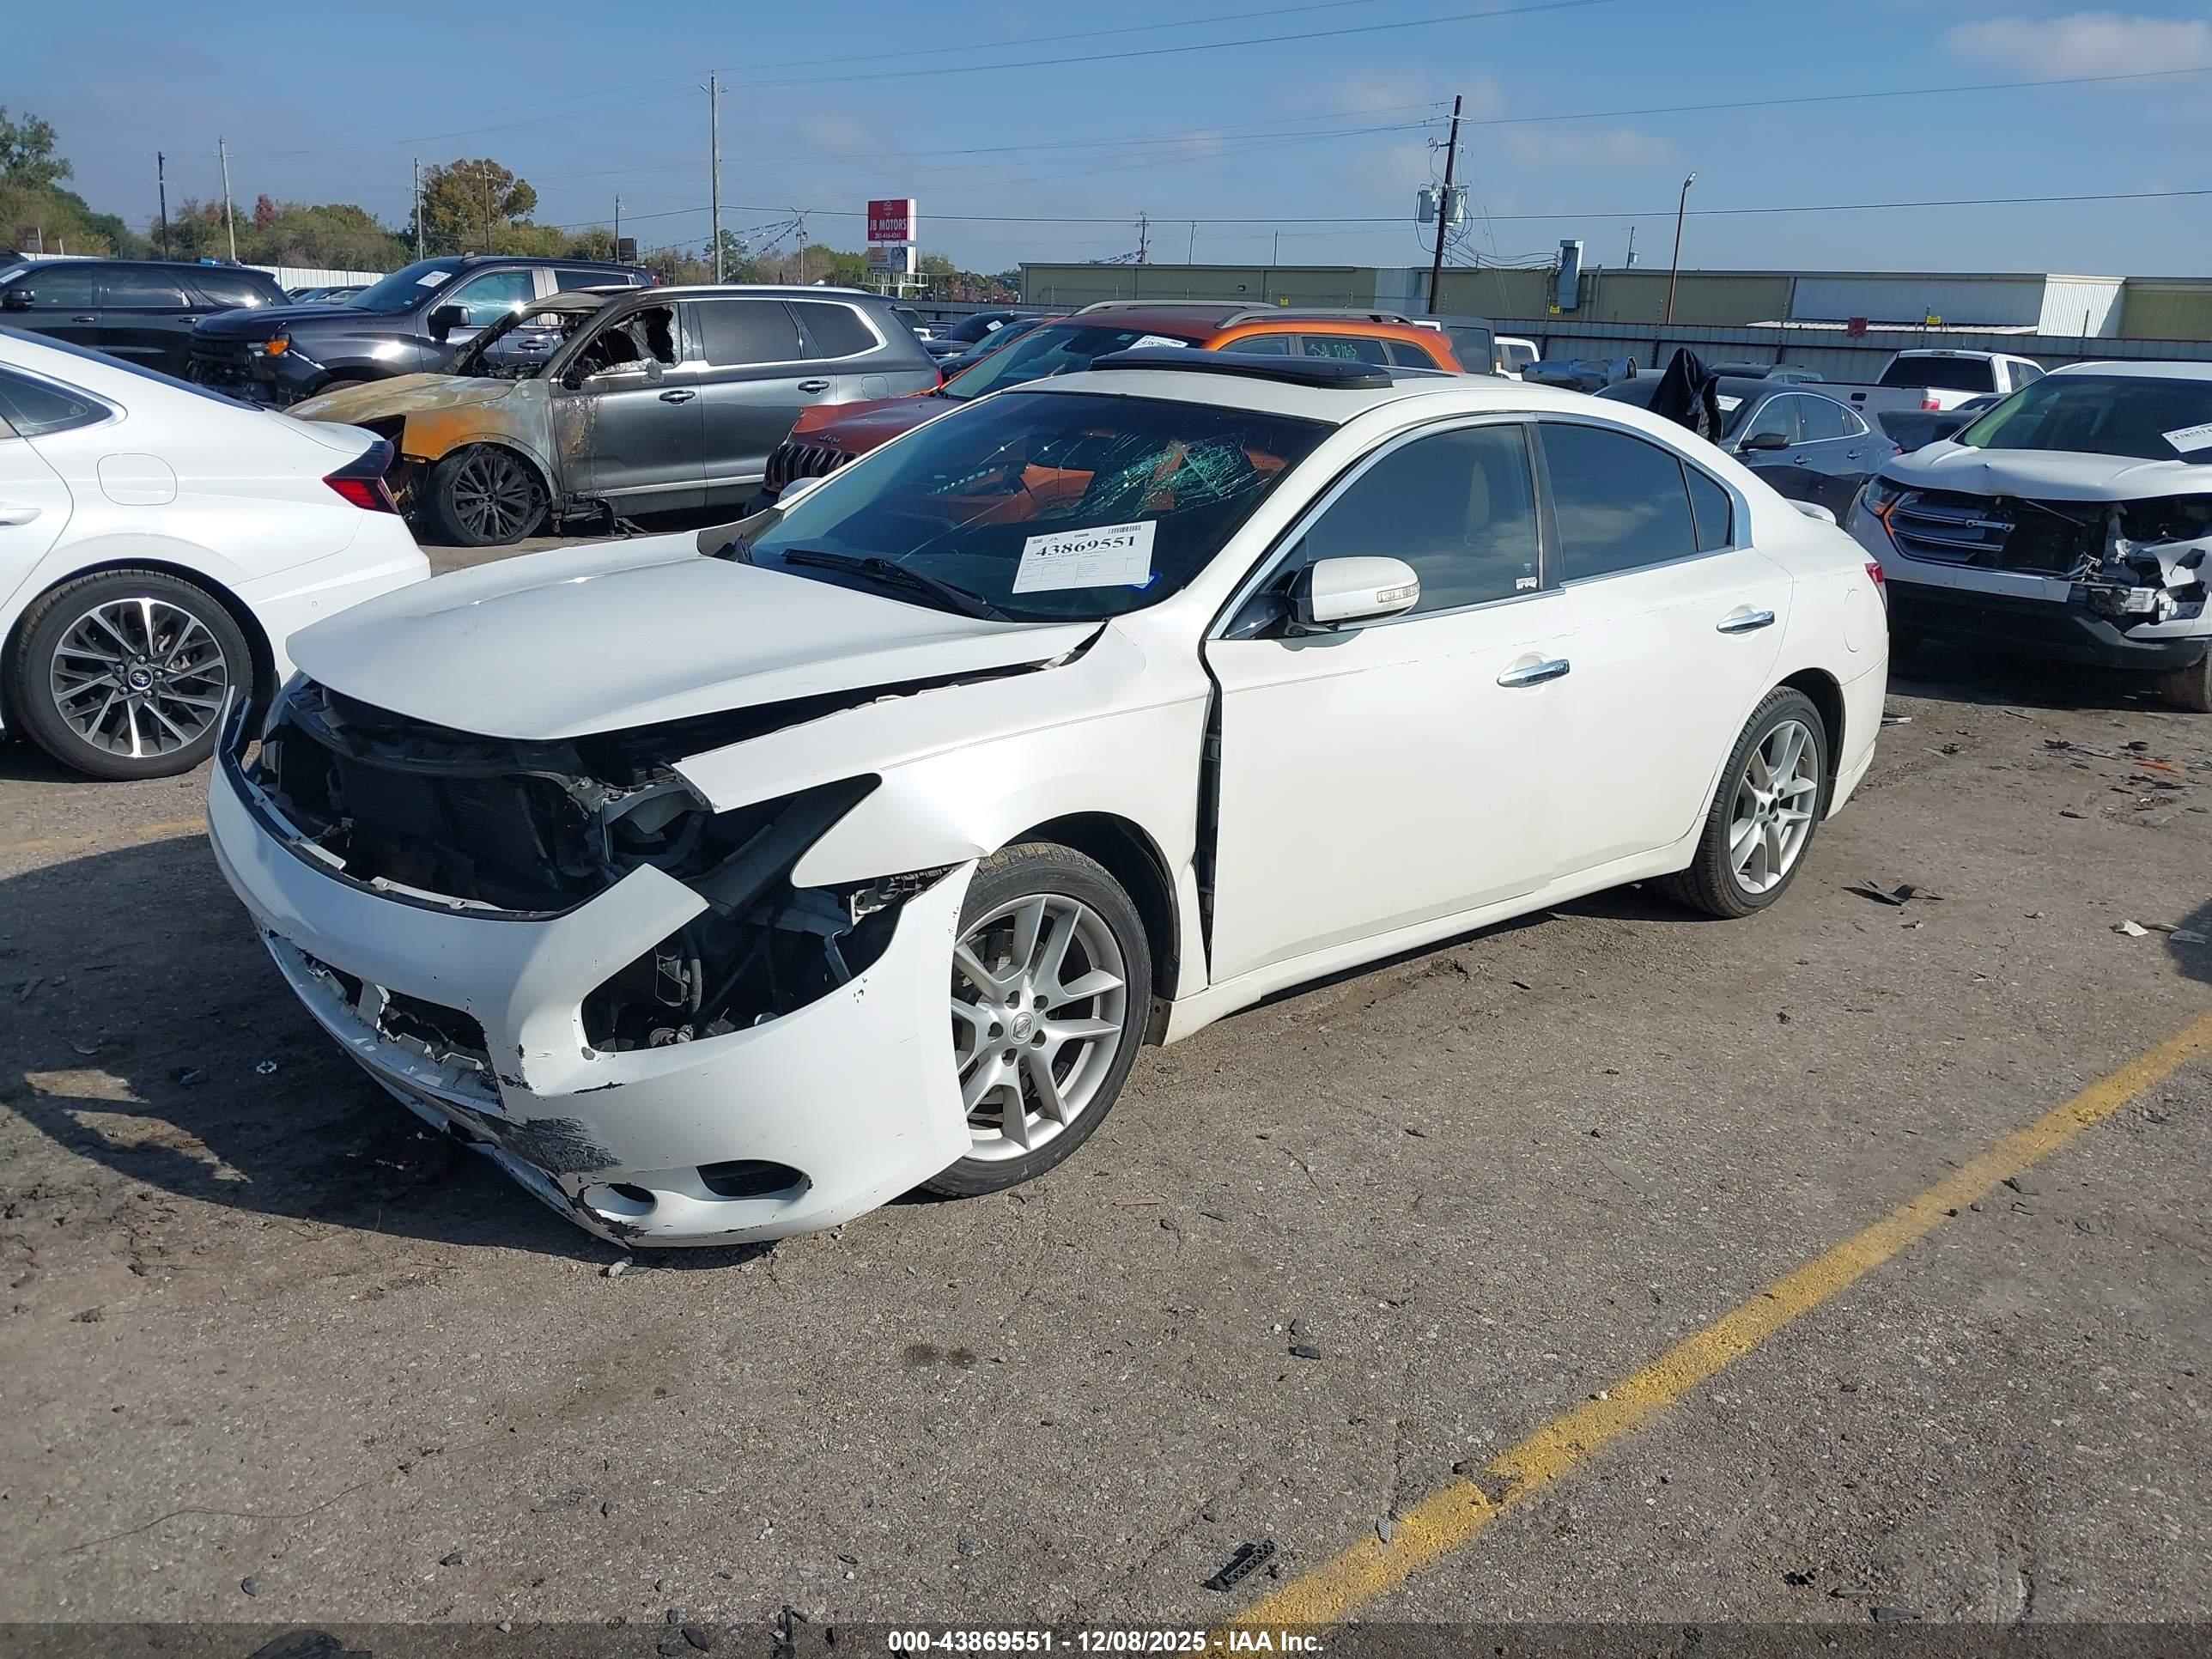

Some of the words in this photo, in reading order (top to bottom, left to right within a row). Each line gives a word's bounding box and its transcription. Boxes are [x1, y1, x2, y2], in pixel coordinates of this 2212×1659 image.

[869, 219, 878, 231] JB
[878, 218, 907, 231] MOTORS
[1036, 535, 1135, 556] 43869551
